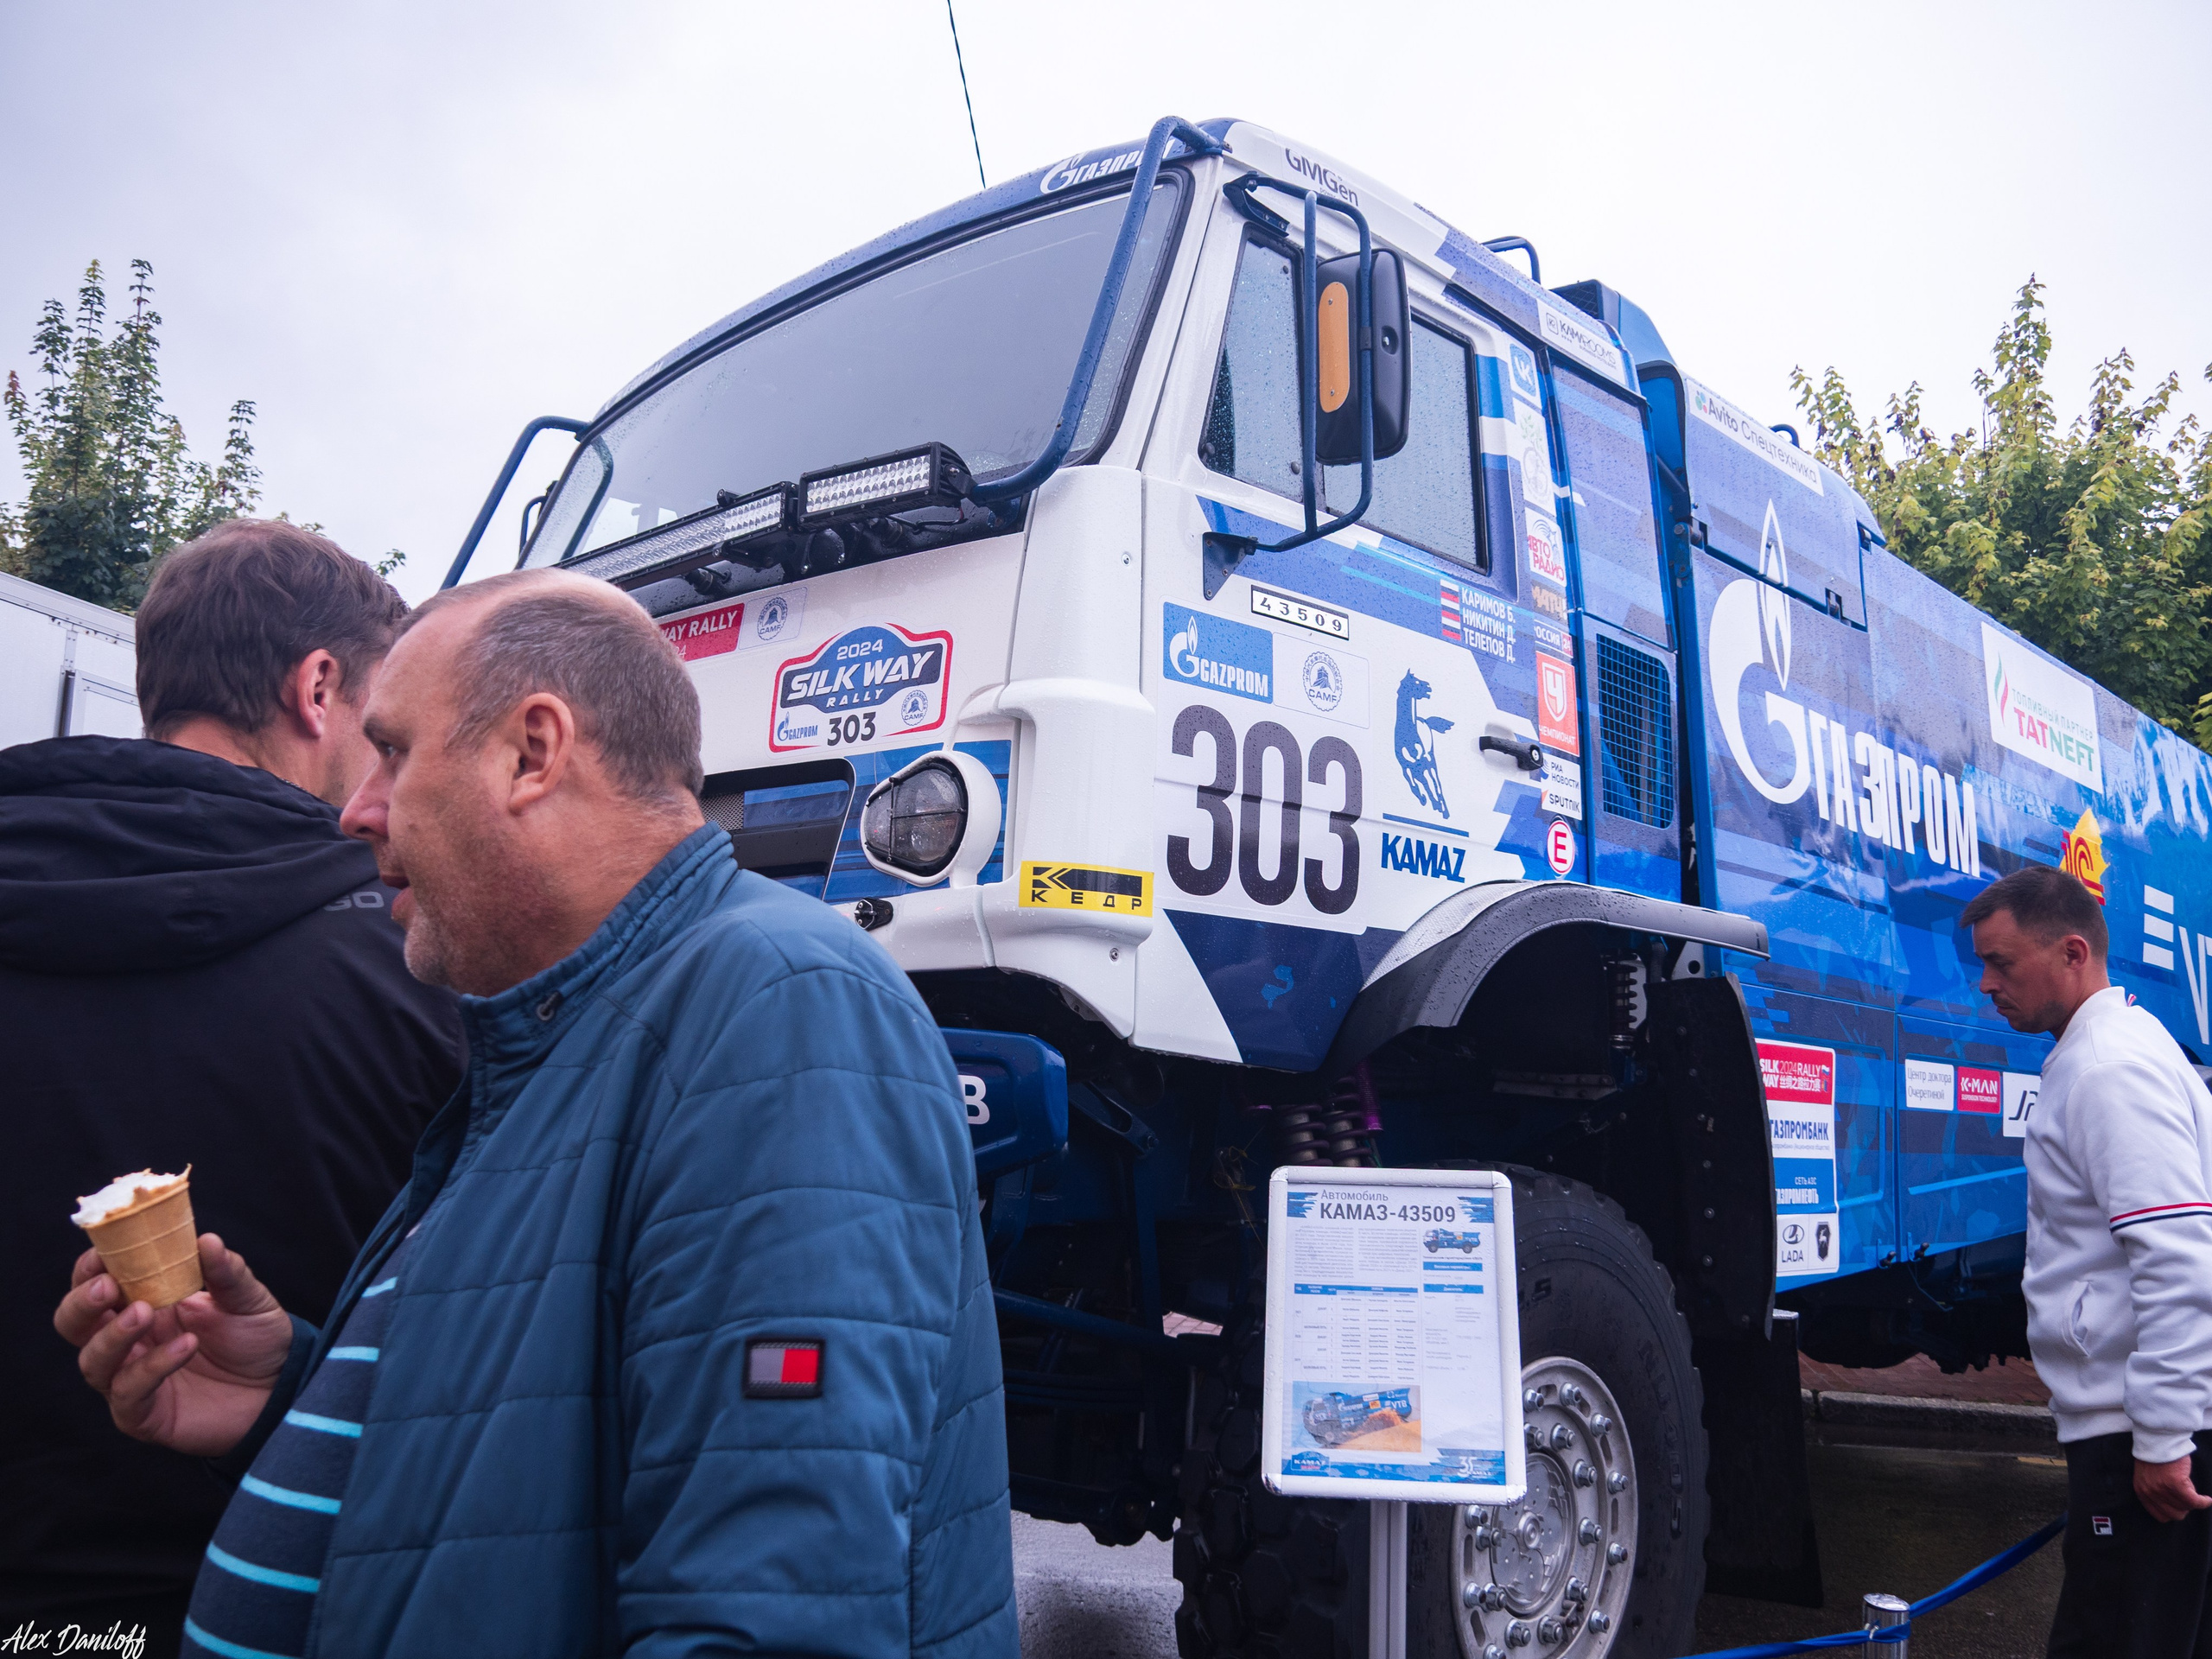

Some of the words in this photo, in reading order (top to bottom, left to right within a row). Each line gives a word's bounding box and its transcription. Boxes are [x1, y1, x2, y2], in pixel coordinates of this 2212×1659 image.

[1072, 138, 1176, 185] ГАЗПР
[1285, 147, 1359, 207] GMGen
[1707, 397, 1738, 433] Avito
[1741, 420, 1817, 484] Спецтехника
[1532, 553, 1565, 582] РАДИО
[1259, 596, 1343, 632] 43509
[1461, 587, 1506, 620] КАРИМОВ
[1507, 605, 1516, 623] Б.
[688, 610, 738, 638] RALLY
[759, 624, 782, 636] CAMF
[1462, 607, 1506, 639] НИКИТИН
[1534, 625, 1561, 646] ОССИЯ
[836, 639, 884, 661] 2024
[1463, 626, 1505, 658] ТЕЛЕПОВ
[786, 663, 861, 702] SILK
[862, 650, 936, 687] WAY
[1199, 657, 1268, 698] GAZPROM
[825, 688, 885, 709] RALLY
[1307, 688, 1338, 704] CAMF
[904, 712, 924, 721] CAMF
[2011, 688, 2059, 726] ТОПЛИВНЫЙ
[2059, 715, 2094, 741] ПАРТНЕР
[788, 724, 819, 741] GAZPROM
[826, 711, 878, 747] 303
[1538, 725, 1576, 747] ЧЕМПИОНАТ
[2013, 706, 2094, 772] TATNEFT
[1550, 761, 1563, 774] РИА
[1551, 773, 1580, 790] НОВОСТИ
[1808, 708, 1981, 878] ГАЗПРОМ
[1166, 704, 1363, 915] 303
[1548, 793, 1580, 813] SPUTNIK
[1381, 832, 1466, 884] KAMAZ
[1554, 830, 1567, 865] E
[1031, 889, 1142, 911] КЕДР
[1759, 1058, 1780, 1074] SILK
[1797, 1061, 1821, 1078] RALLY
[1907, 1067, 1927, 1083] Центр
[1927, 1071, 1952, 1084] доктора
[1763, 1073, 1779, 1089] WAY
[1320, 1188, 1389, 1202] Автомобиль
[1319, 1202, 1456, 1223] КАМАЗ-43509
[1781, 1249, 1804, 1263] LADA
